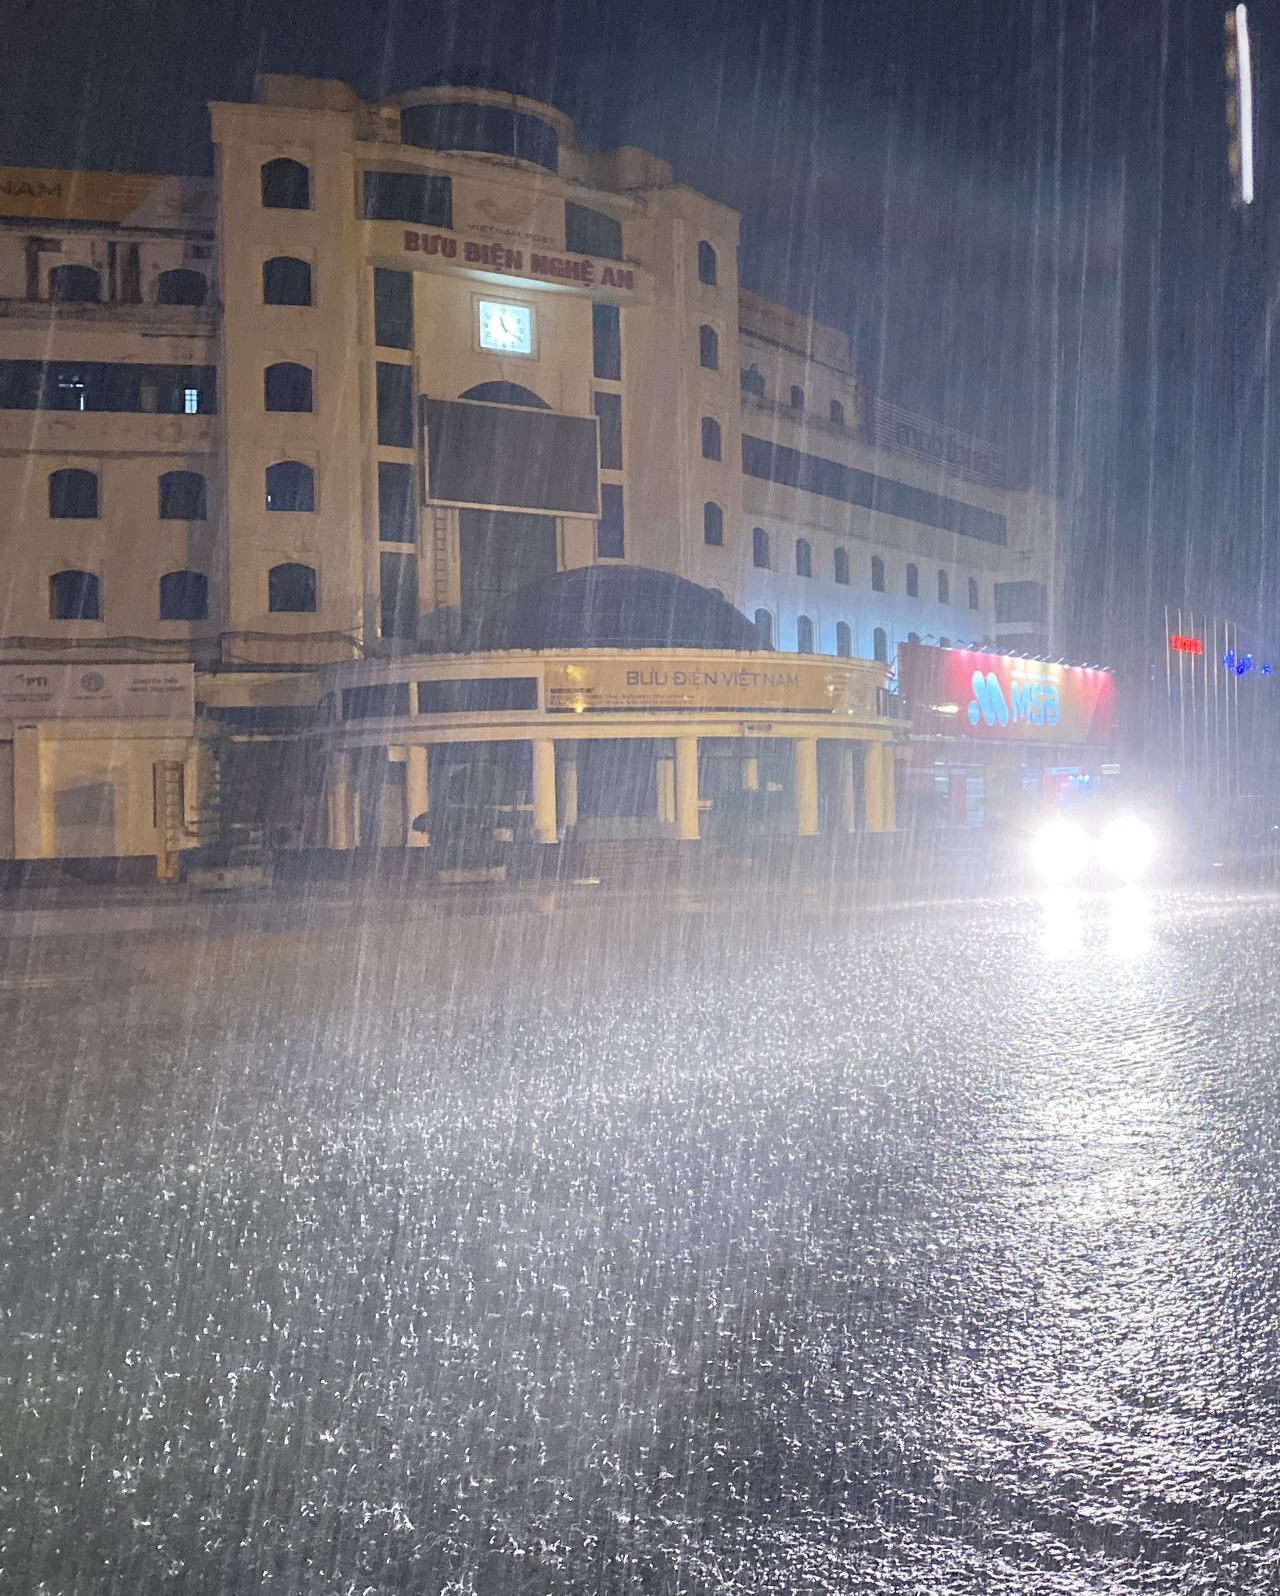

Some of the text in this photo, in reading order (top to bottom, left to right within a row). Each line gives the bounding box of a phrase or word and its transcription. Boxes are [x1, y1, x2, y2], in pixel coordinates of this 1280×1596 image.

[404, 229, 634, 290] BƯU ĐIỆN NGHỆ AN
[626, 667, 799, 690] BƯU ĐIỆN VIỆT NAM
[1011, 680, 1060, 726] MSB
